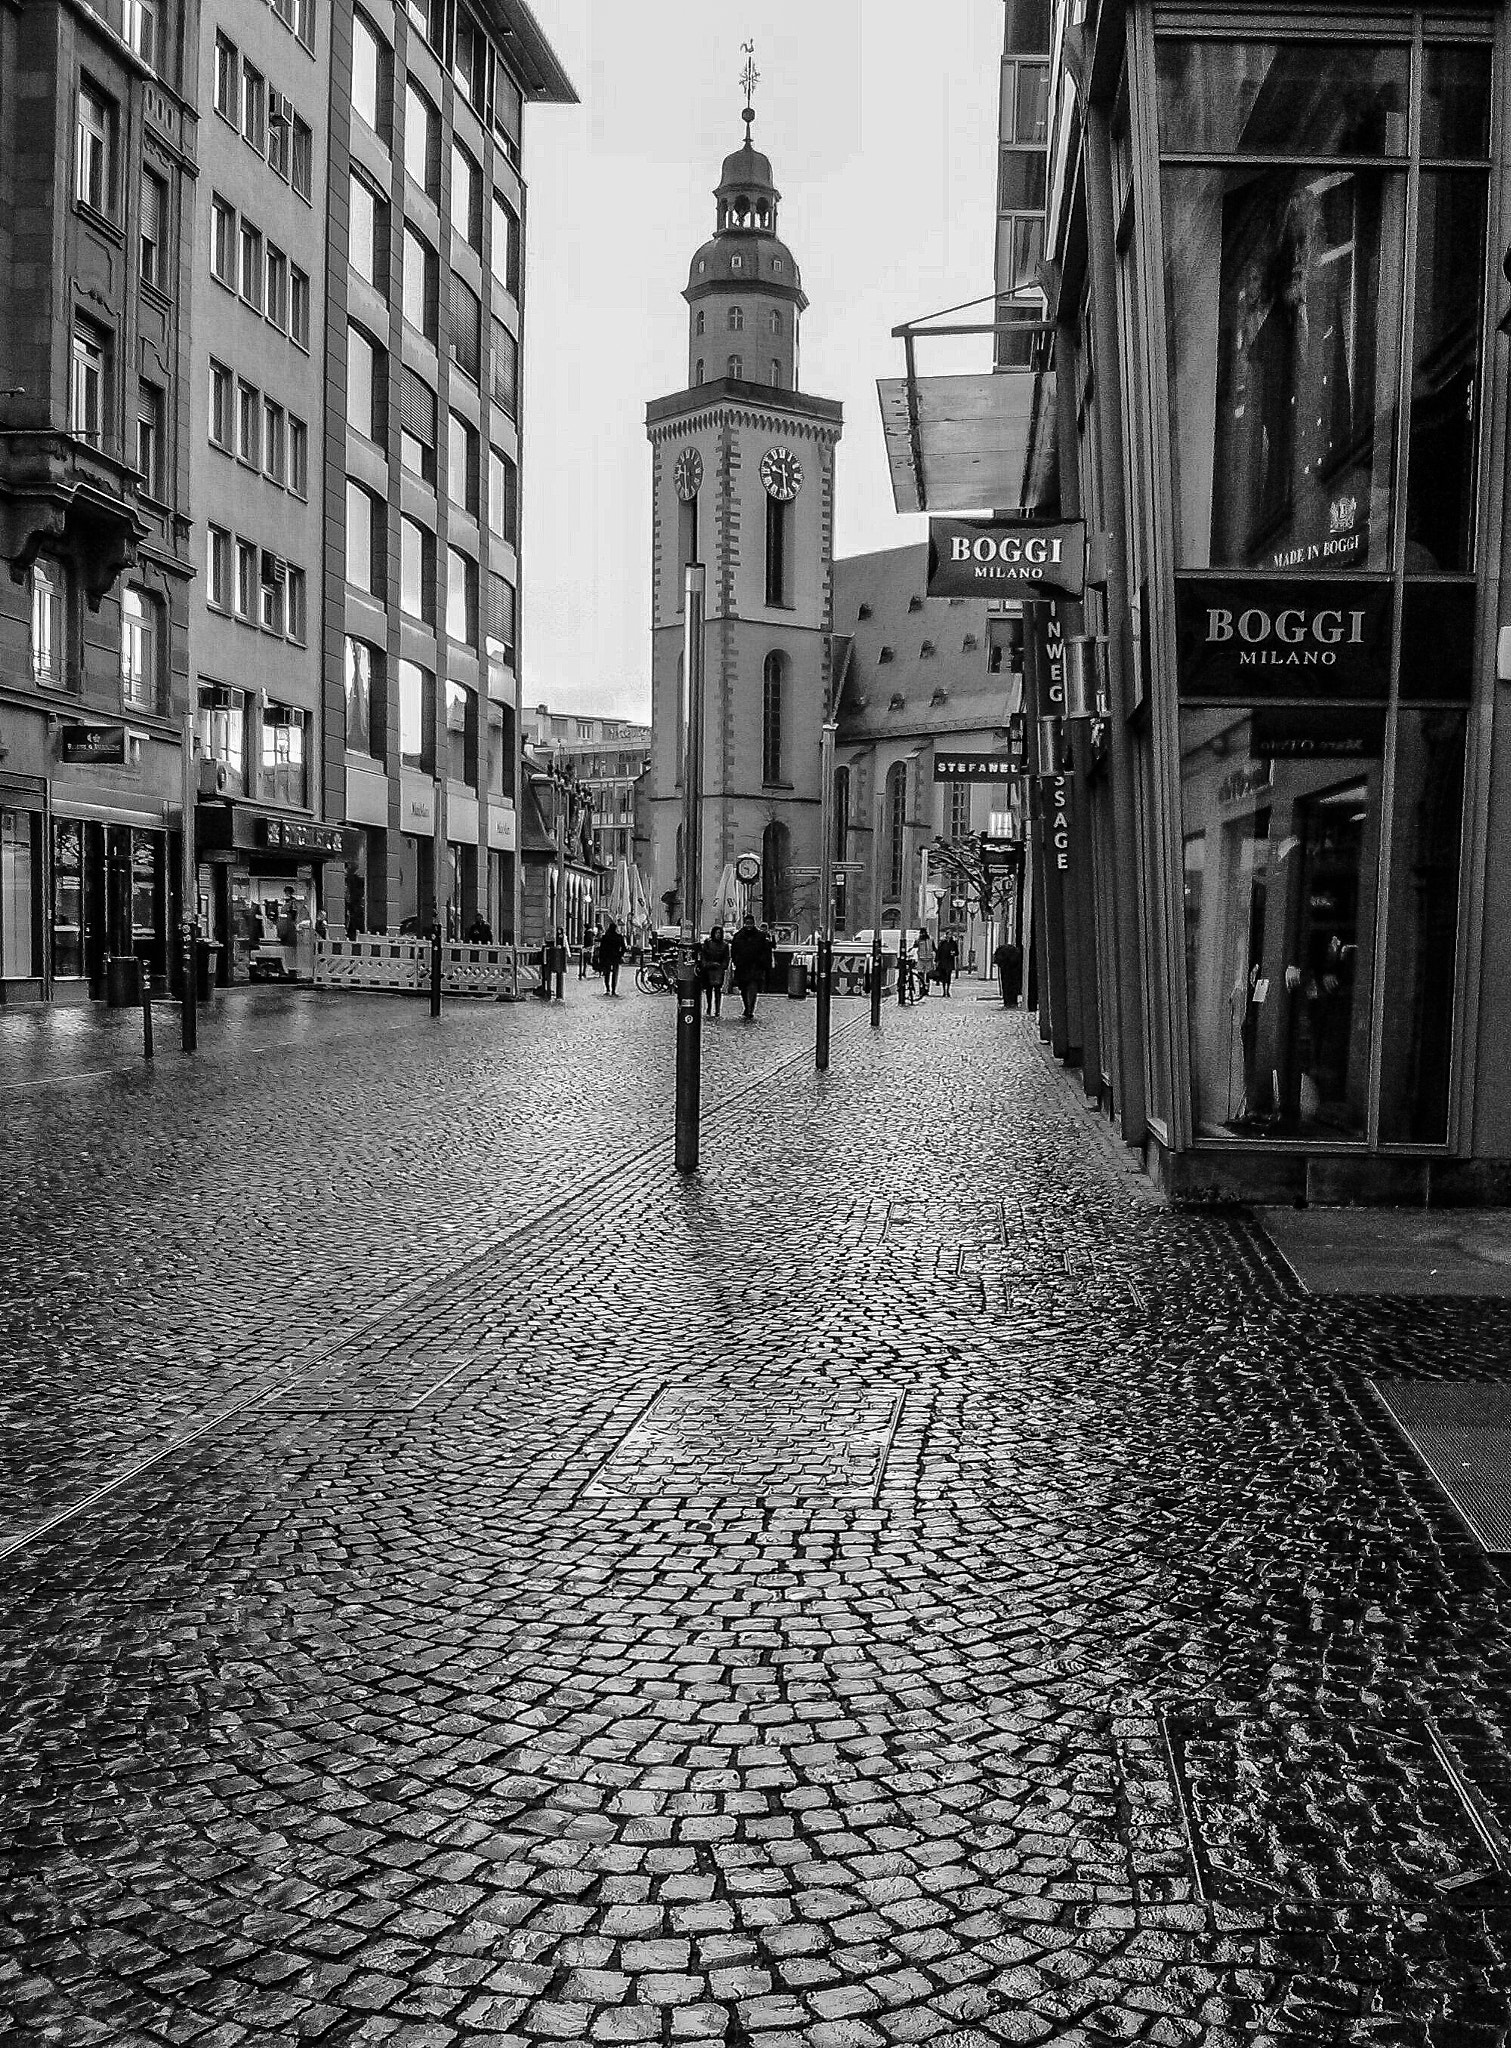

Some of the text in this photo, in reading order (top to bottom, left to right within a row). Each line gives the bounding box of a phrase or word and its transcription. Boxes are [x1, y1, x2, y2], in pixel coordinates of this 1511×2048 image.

[951, 537, 1062, 563] BOGGI
[1274, 535, 1359, 567] MADE IN BOGGI
[974, 567, 1043, 579] MILANO
[1205, 609, 1366, 643] BOGGI
[1239, 651, 1336, 665] MILANO
[938, 763, 1018, 773] STEFANEL
[1053, 776, 1068, 869] SSAGE
